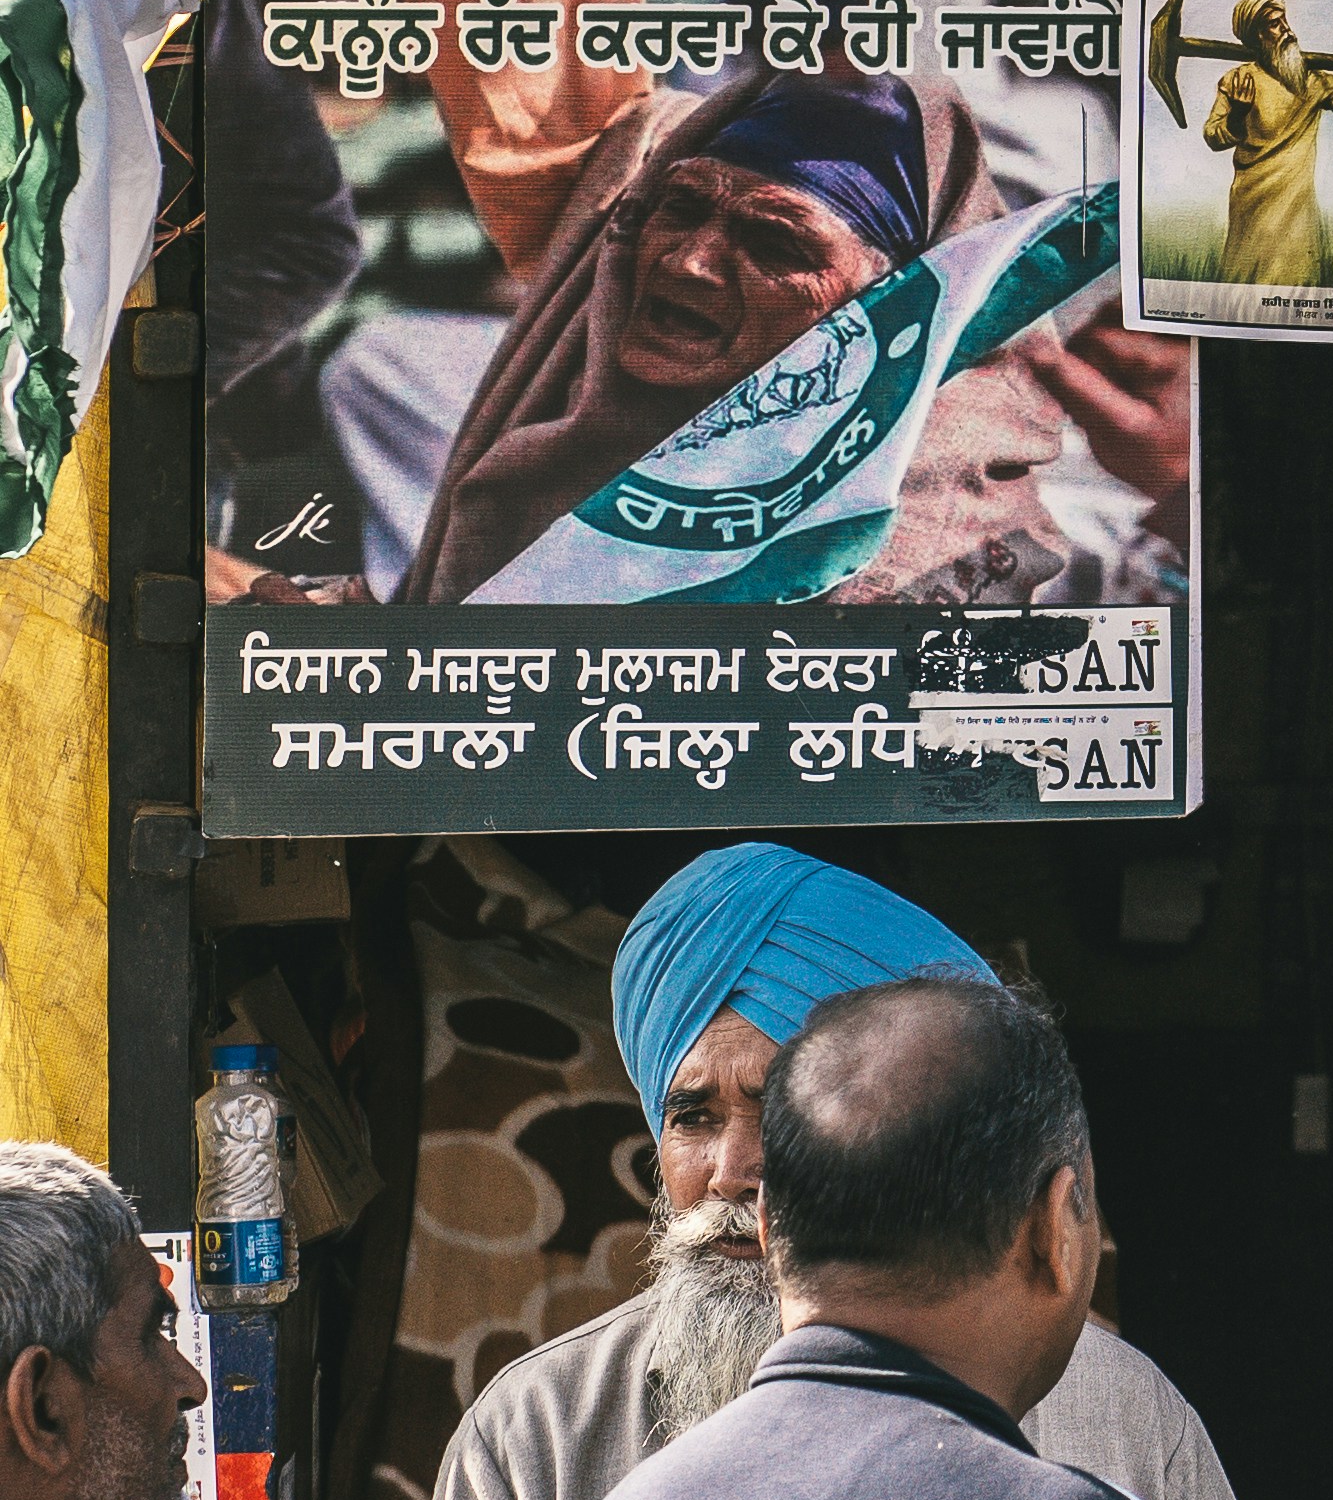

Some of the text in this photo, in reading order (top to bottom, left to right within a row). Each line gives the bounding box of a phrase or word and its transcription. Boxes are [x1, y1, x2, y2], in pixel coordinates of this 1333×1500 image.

[576, 0, 752, 75] ਕਰਵਾ
[239, 628, 897, 714] ਕਿਸਾਨ ਮਜ਼ਦੂਰ ਮੁਲਾਜ਼ਮ ਏਕਤਾ
[1038, 638, 1161, 693] SAN
[271, 718, 532, 773] ਸਮਰਾਲਾ
[1043, 736, 1162, 790] SAN
